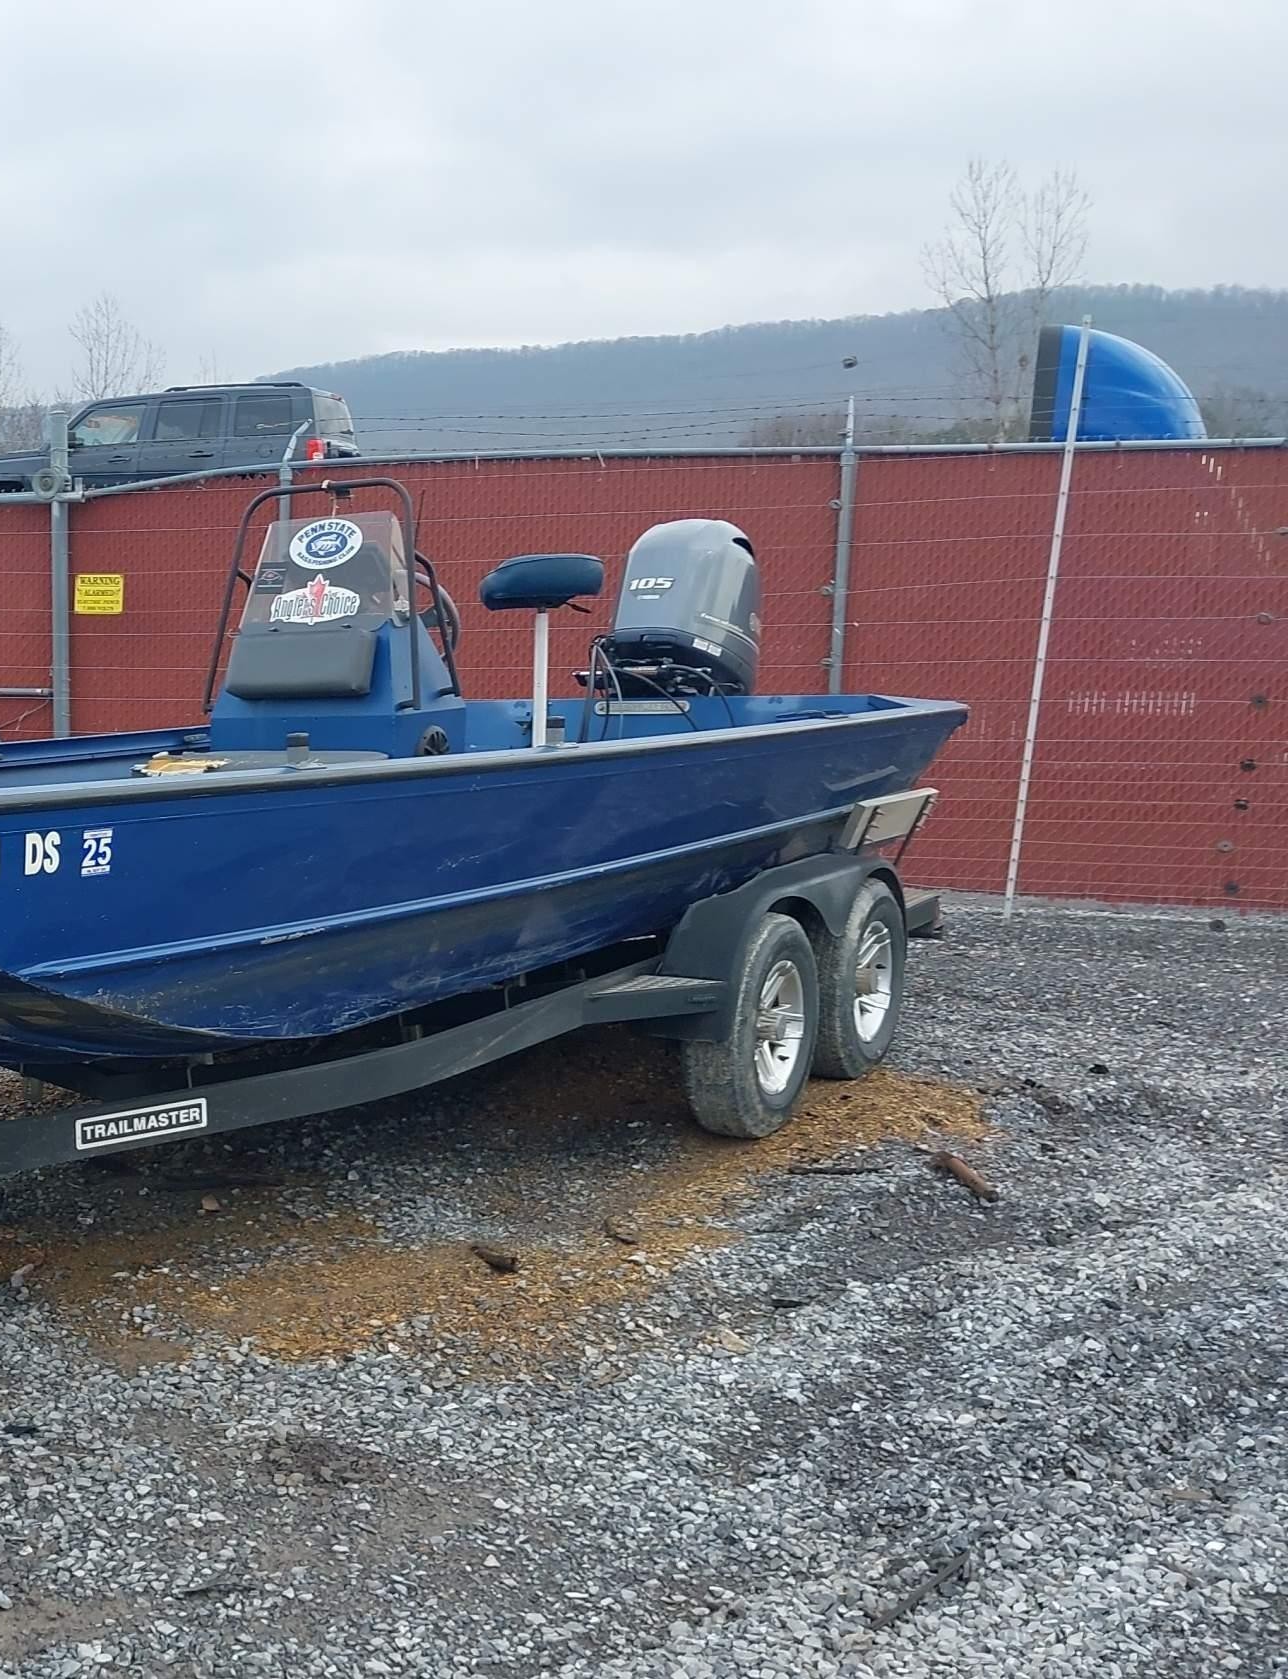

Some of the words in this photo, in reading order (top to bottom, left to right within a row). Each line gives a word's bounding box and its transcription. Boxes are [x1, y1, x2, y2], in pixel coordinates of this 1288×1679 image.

[327, 521, 357, 538] STATE
[629, 577, 674, 590] 105
[320, 593, 357, 616] Choice
[24, 831, 61, 876] DS
[82, 838, 112, 867] 25
[83, 1107, 201, 1140] TRAILMASTER
